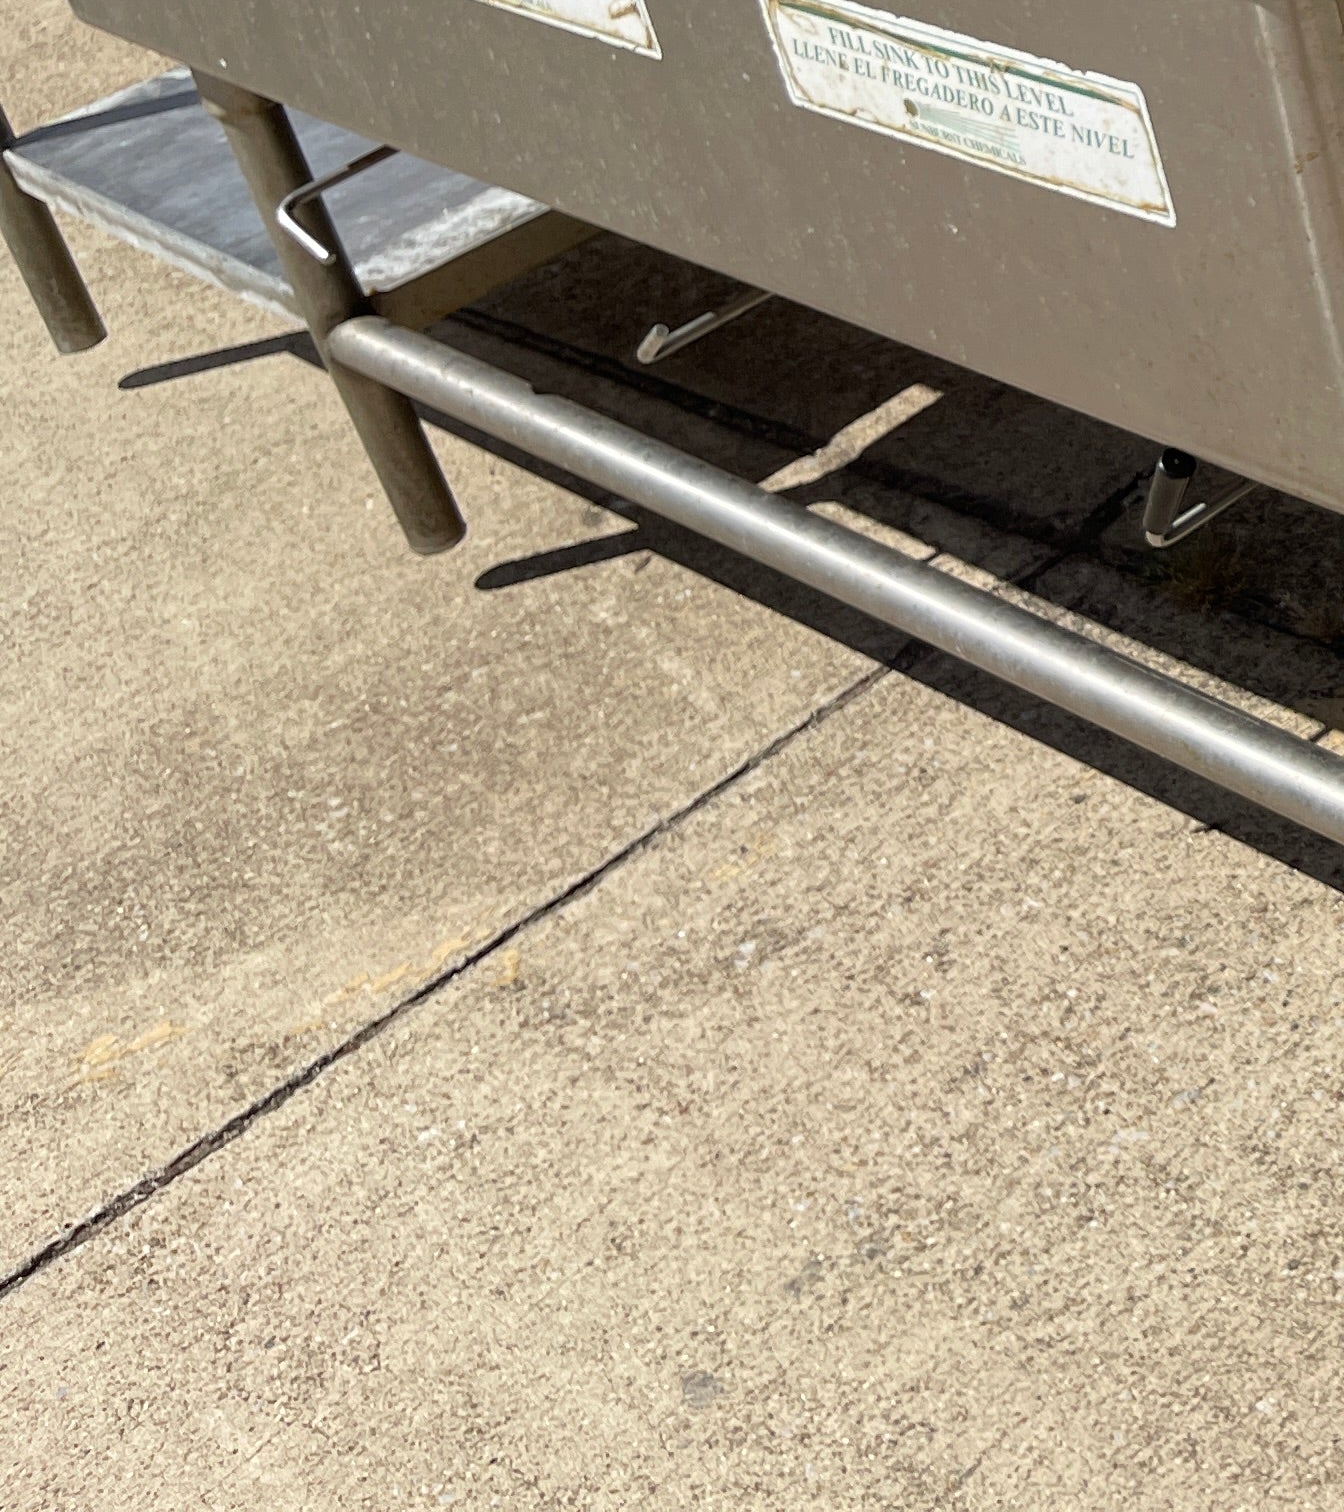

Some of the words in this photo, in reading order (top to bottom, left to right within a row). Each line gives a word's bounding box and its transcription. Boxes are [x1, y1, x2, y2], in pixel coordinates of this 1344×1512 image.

[792, 38, 850, 71] LLENE
[854, 56, 878, 80] EL
[881, 65, 994, 117] FREGADERO
[1000, 105, 1012, 123] A
[1016, 106, 1066, 138] ESTE
[1070, 123, 1135, 159] NIVEL
[828, 26, 872, 57] FILL
[872, 39, 920, 71] SINK
[919, 54, 949, 79] TO
[951, 63, 1000, 94] THIS
[1001, 76, 1074, 118] LEVEL
